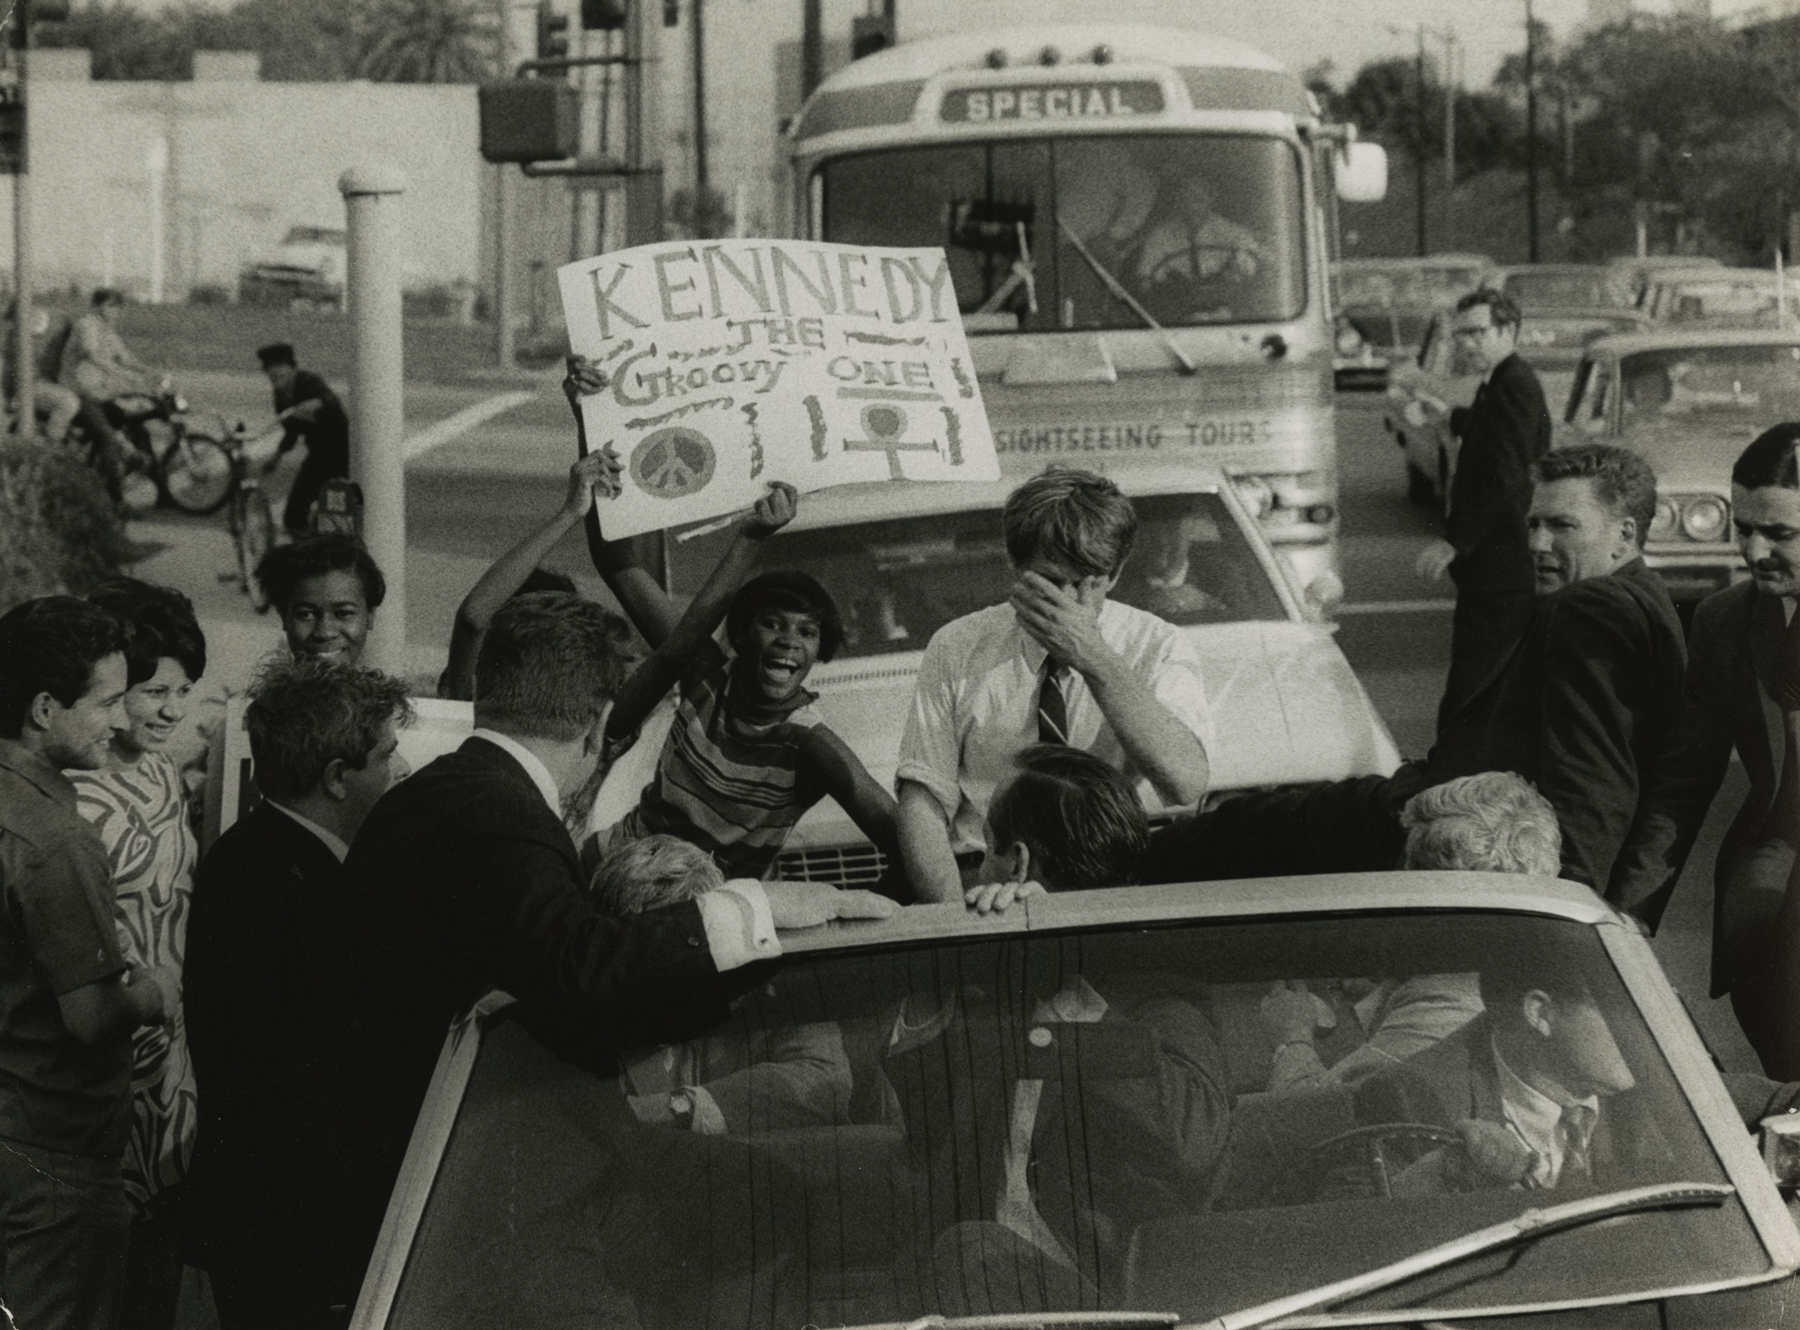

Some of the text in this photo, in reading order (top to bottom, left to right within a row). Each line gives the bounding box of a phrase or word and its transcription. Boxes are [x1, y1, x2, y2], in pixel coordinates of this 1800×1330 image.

[966, 86, 1135, 121] SPECIAL
[588, 245, 948, 340] KENNEDY
[726, 317, 826, 348] THE
[994, 424, 1163, 453] SIGHTSEEING
